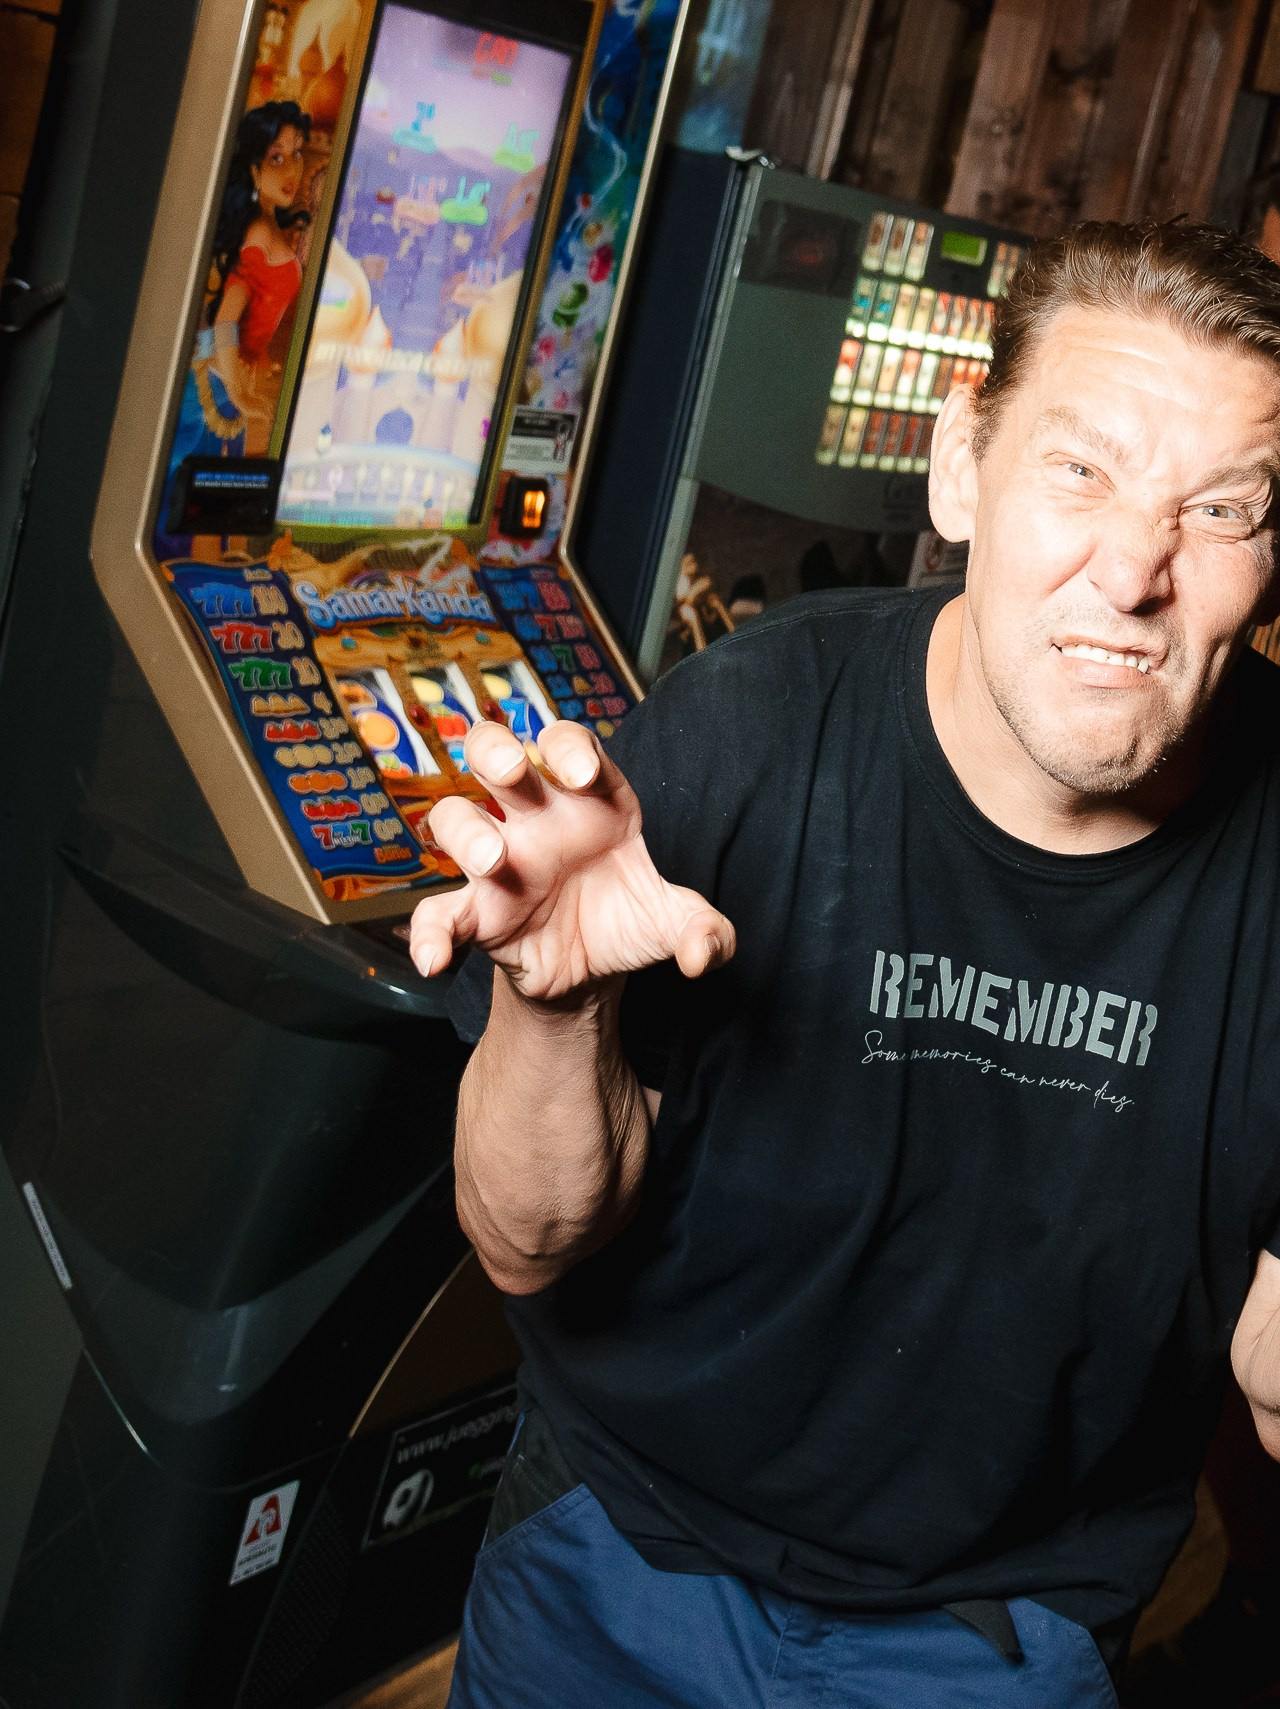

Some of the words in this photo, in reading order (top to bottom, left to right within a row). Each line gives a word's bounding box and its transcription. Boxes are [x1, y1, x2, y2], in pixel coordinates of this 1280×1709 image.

[294, 574, 498, 632] Samarkanda
[209, 620, 275, 653] 777
[227, 656, 294, 692] 777
[869, 950, 1158, 1066] REMEMBER
[861, 1030, 907, 1064] Some
[908, 1048, 997, 1074] memories
[1000, 1066, 1036, 1085] can
[1038, 1075, 1092, 1093] never
